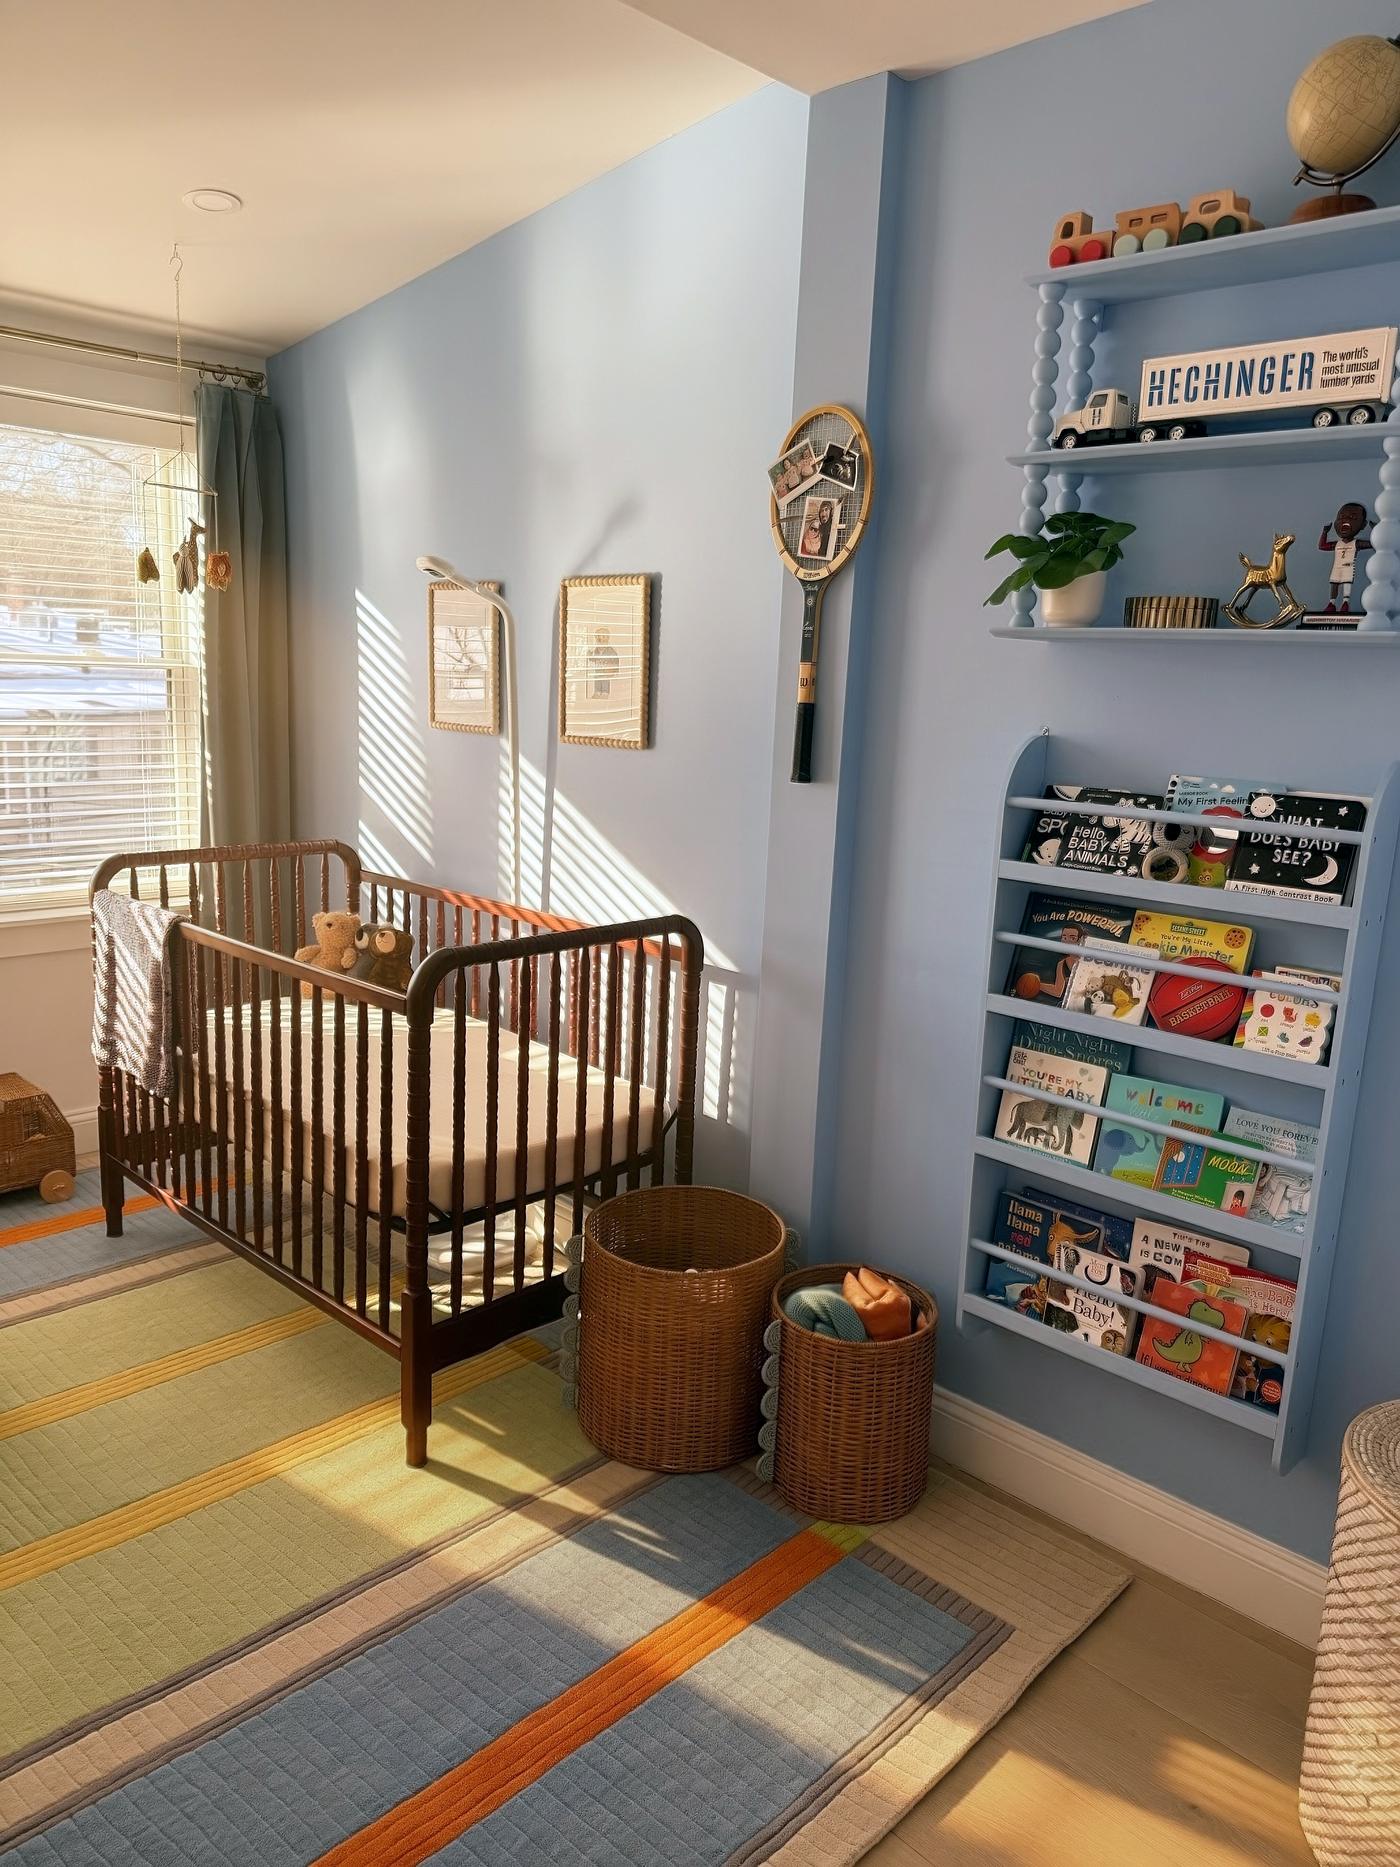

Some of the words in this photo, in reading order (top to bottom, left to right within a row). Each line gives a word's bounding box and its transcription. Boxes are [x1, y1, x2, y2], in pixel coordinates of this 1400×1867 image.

[1322, 350, 1338, 364] The
[1339, 346, 1369, 361] world's
[1321, 362, 1344, 376] most
[1345, 358, 1380, 374] unusual
[1147, 351, 1315, 407] HECHINGER
[1320, 375, 1350, 389] lumber
[1350, 373, 1376, 388] yards
[1177, 797, 1194, 807] My
[1196, 796, 1217, 806] First
[1278, 814, 1324, 828] WHAT
[1072, 825, 1108, 840] Hello,
[1249, 831, 1292, 847] DOES
[1297, 837, 1341, 852] BABY
[1068, 836, 1110, 853] BABY
[1063, 849, 1129, 868] ANIMALS
[1271, 848, 1312, 867] SEE?
[1241, 884, 1259, 893] First
[1260, 886, 1312, 901] High-Contrast
[1313, 893, 1334, 903] Book
[1032, 914, 1048, 924] You
[1049, 911, 1066, 921] Are
[1066, 909, 1124, 938] POWERFUL
[1136, 937, 1178, 953] Cookie
[1180, 943, 1235, 963] Monster
[1160, 933, 1181, 942] You're
[1182, 936, 1192, 944] My
[1193, 938, 1214, 948] Little
[1168, 988, 1235, 1027] BASKETBALL
[1026, 1022, 1067, 1044] Night
[1019, 1034, 1122, 1073] Dino-Snores
[1023, 1066, 1062, 1083] YOU'RE
[1065, 1076, 1083, 1089] MY
[1009, 1073, 1054, 1093] LITTLE
[1056, 1085, 1096, 1104] BABY
[1125, 1088, 1205, 1115] welcome
[1235, 1118, 1259, 1130] LOVE
[1260, 1123, 1281, 1135] YOU
[1208, 1155, 1249, 1176] MOON
[1008, 1200, 1043, 1224] llama
[1006, 1213, 1041, 1238] llama
[1009, 1231, 1033, 1248] red
[1141, 1234, 1149, 1244] A
[1154, 1238, 1180, 1252] NEW
[1139, 1249, 1150, 1258] IS
[1153, 1252, 1182, 1267] COM
[1242, 1286, 1264, 1298] The
[1072, 1296, 1115, 1328] Baby!
[1248, 1299, 1258, 1309] Is
[1262, 1302, 1290, 1320] Here!
[1139, 1352, 1150, 1366] If
